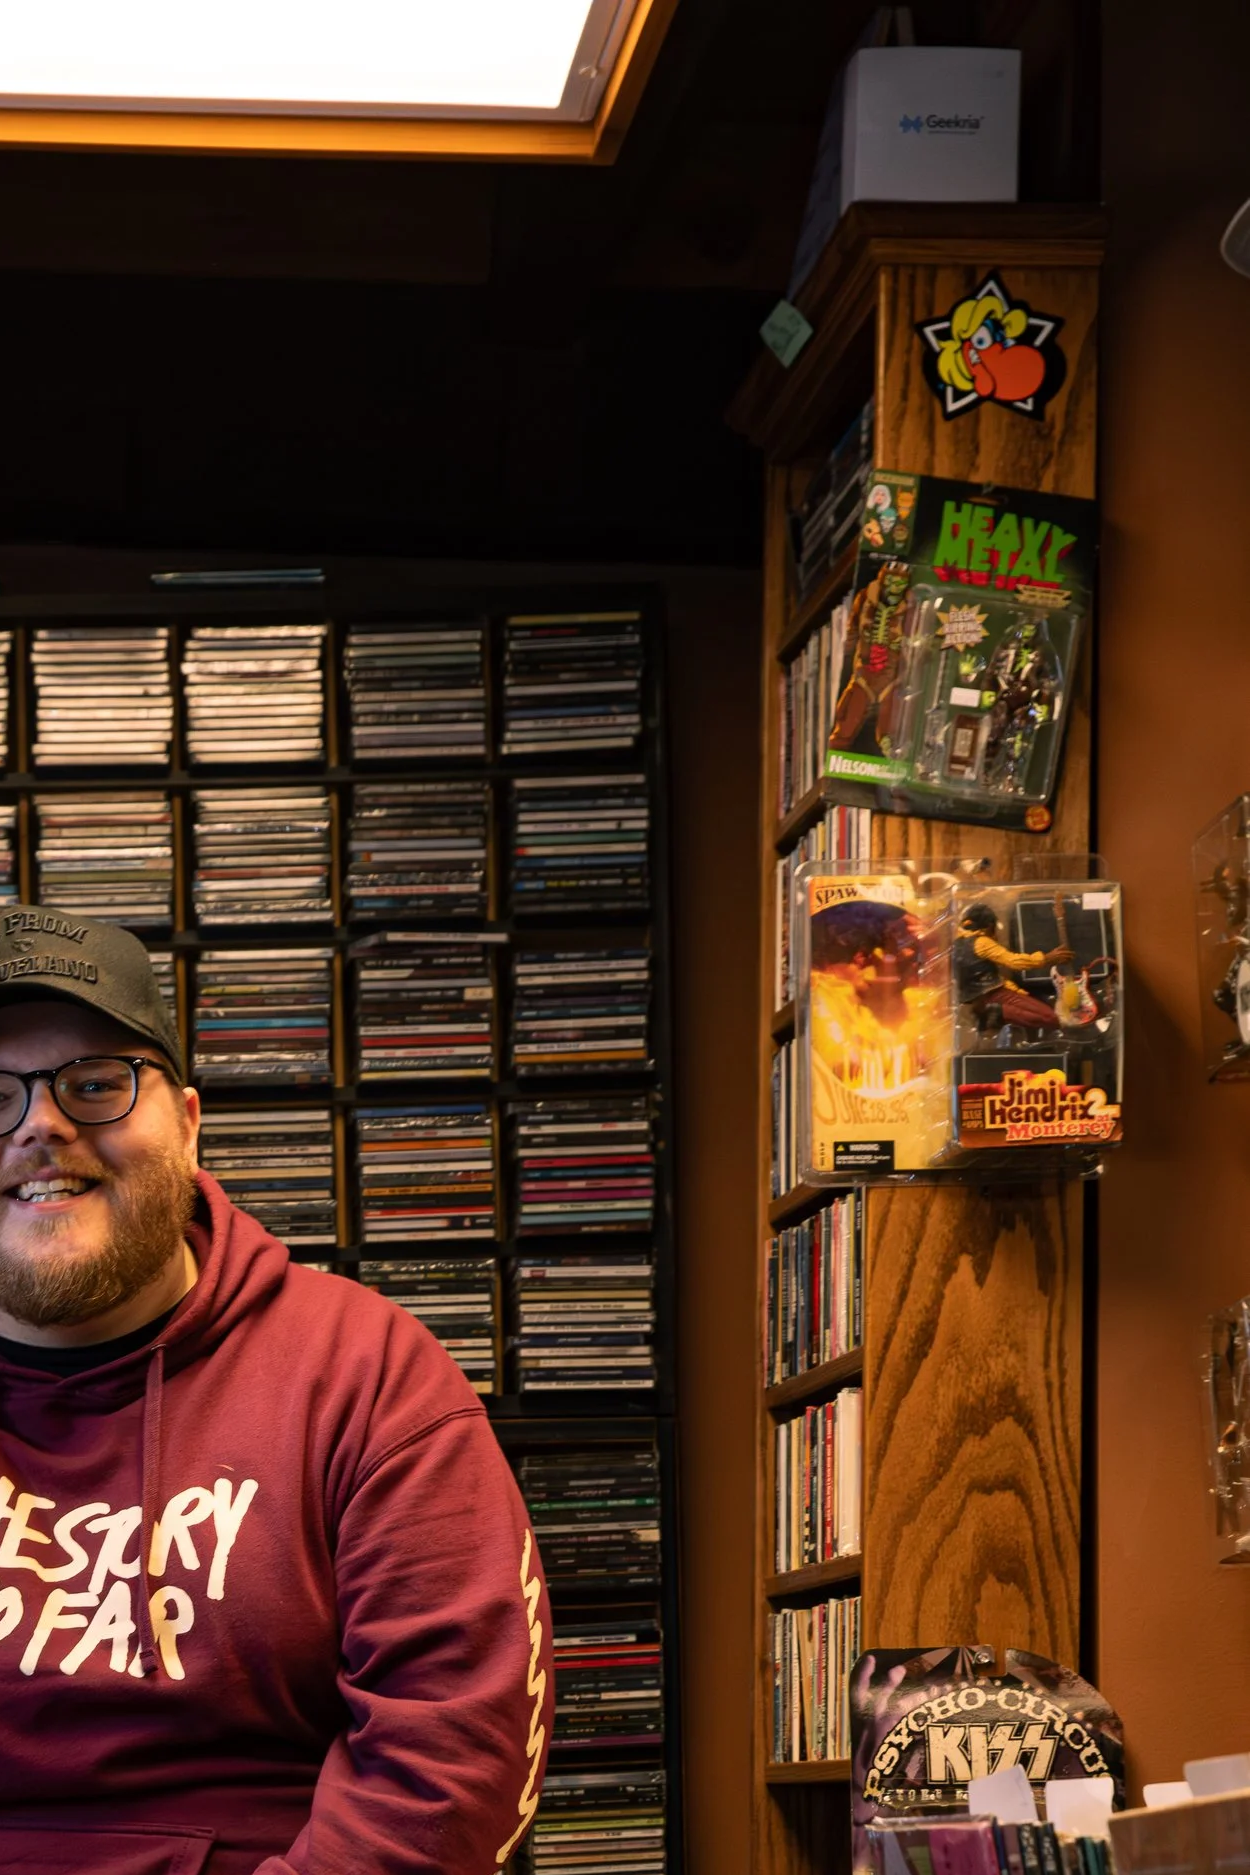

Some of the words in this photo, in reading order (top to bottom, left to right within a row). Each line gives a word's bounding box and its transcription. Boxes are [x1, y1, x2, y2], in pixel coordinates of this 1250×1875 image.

[926, 114, 981, 130] Geekria
[940, 499, 1078, 556] HEAVY
[933, 535, 1067, 583] METAL
[829, 755, 876, 776] NELSON
[4, 911, 90, 944] FROM
[989, 1095, 1095, 1125] Hendrix
[1088, 1090, 1120, 1116] 2
[1001, 1077, 1057, 1108] Jimi
[1007, 1120, 1116, 1141] Monterey
[18, 1580, 196, 1681] FAR
[926, 1721, 1060, 1785] KISS
